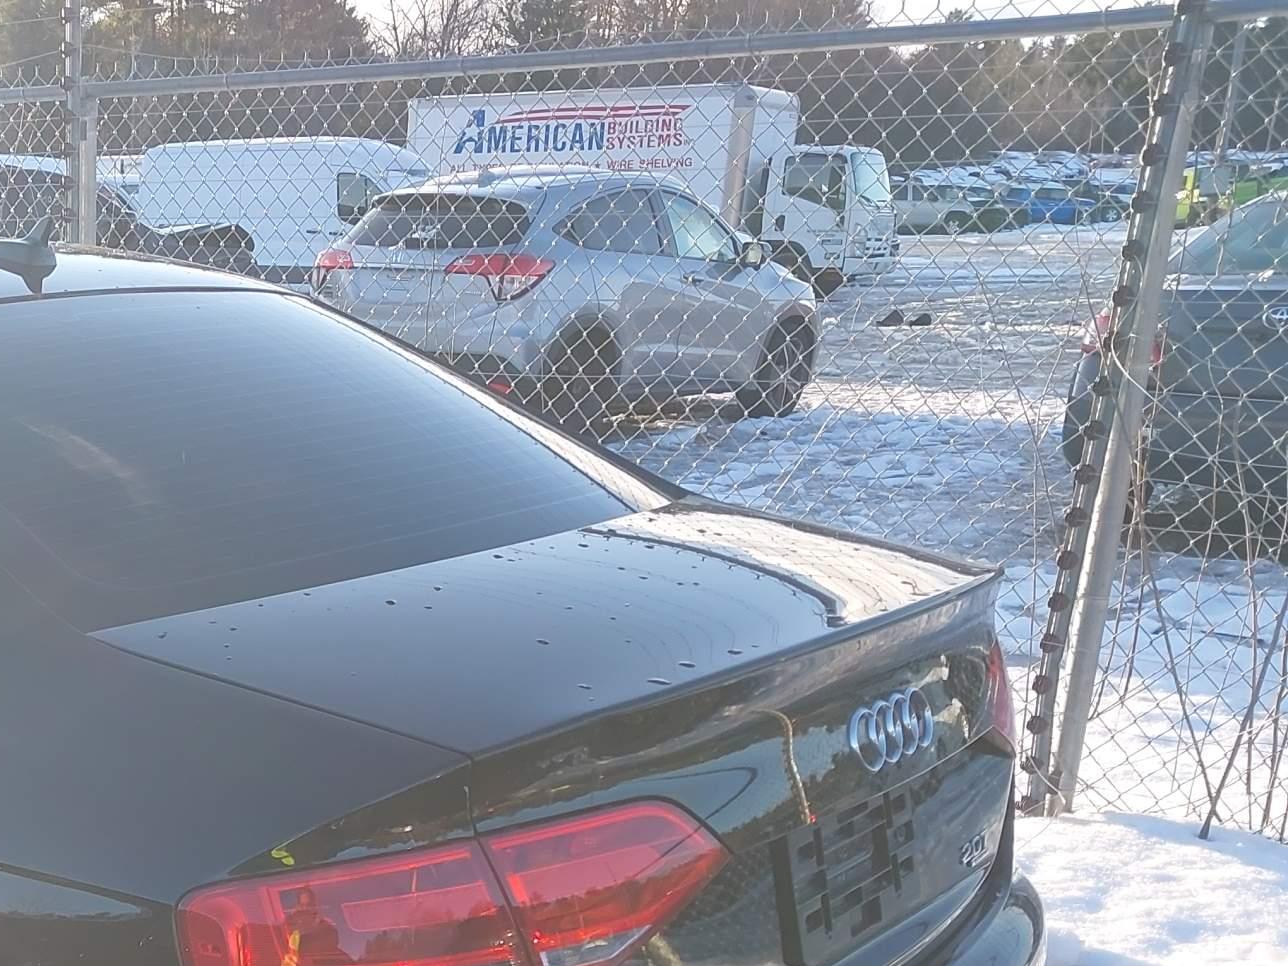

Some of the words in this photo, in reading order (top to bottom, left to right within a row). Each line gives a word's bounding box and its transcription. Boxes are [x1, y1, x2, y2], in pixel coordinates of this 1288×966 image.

[453, 109, 606, 154] AMERICAN
[607, 117, 683, 136] BUILDING
[605, 132, 684, 151] SYSTEMS
[606, 159, 634, 170] WIRE
